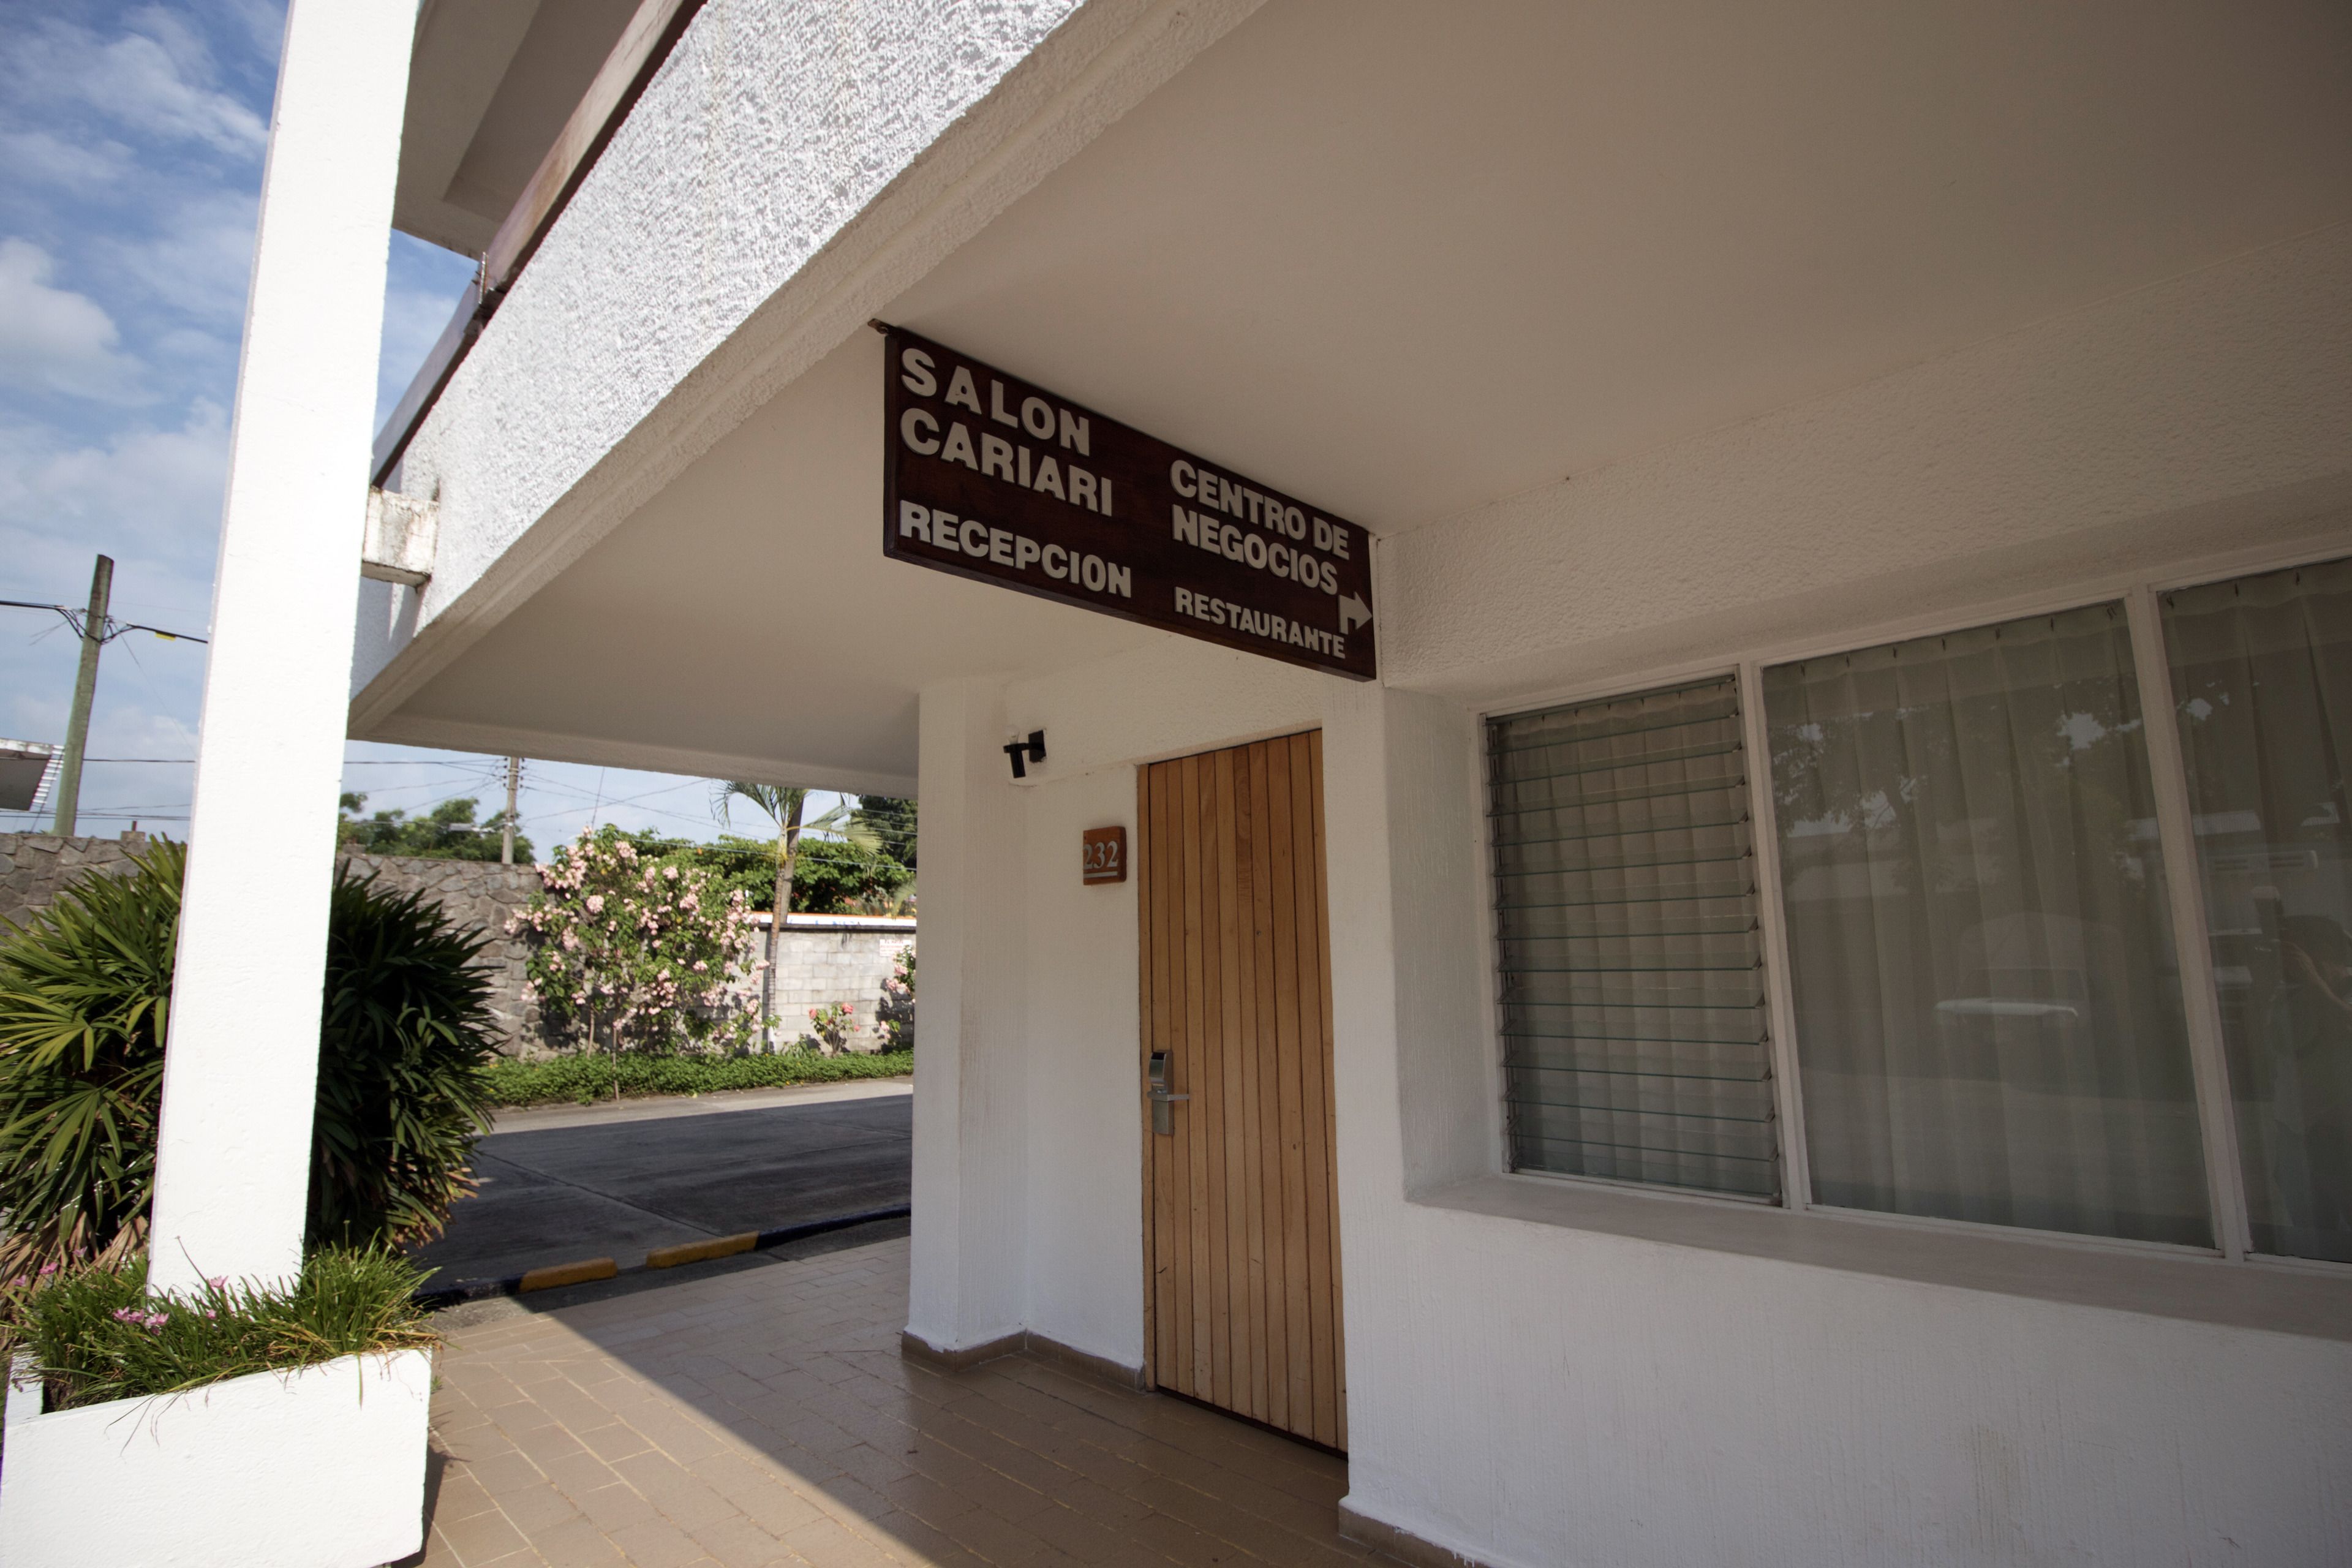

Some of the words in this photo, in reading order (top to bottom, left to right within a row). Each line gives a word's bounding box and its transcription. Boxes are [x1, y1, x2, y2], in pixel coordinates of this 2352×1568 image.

[902, 348, 1090, 456] SALON
[901, 409, 1112, 516] CARIARI
[1170, 460, 1306, 540] CENTRO
[1314, 517, 1349, 559] DE
[900, 500, 1131, 598] RECEPCION
[1172, 505, 1338, 595] NEGOCIOS
[1175, 587, 1345, 658] RESTAURANTE
[1083, 841, 1118, 869] 232
